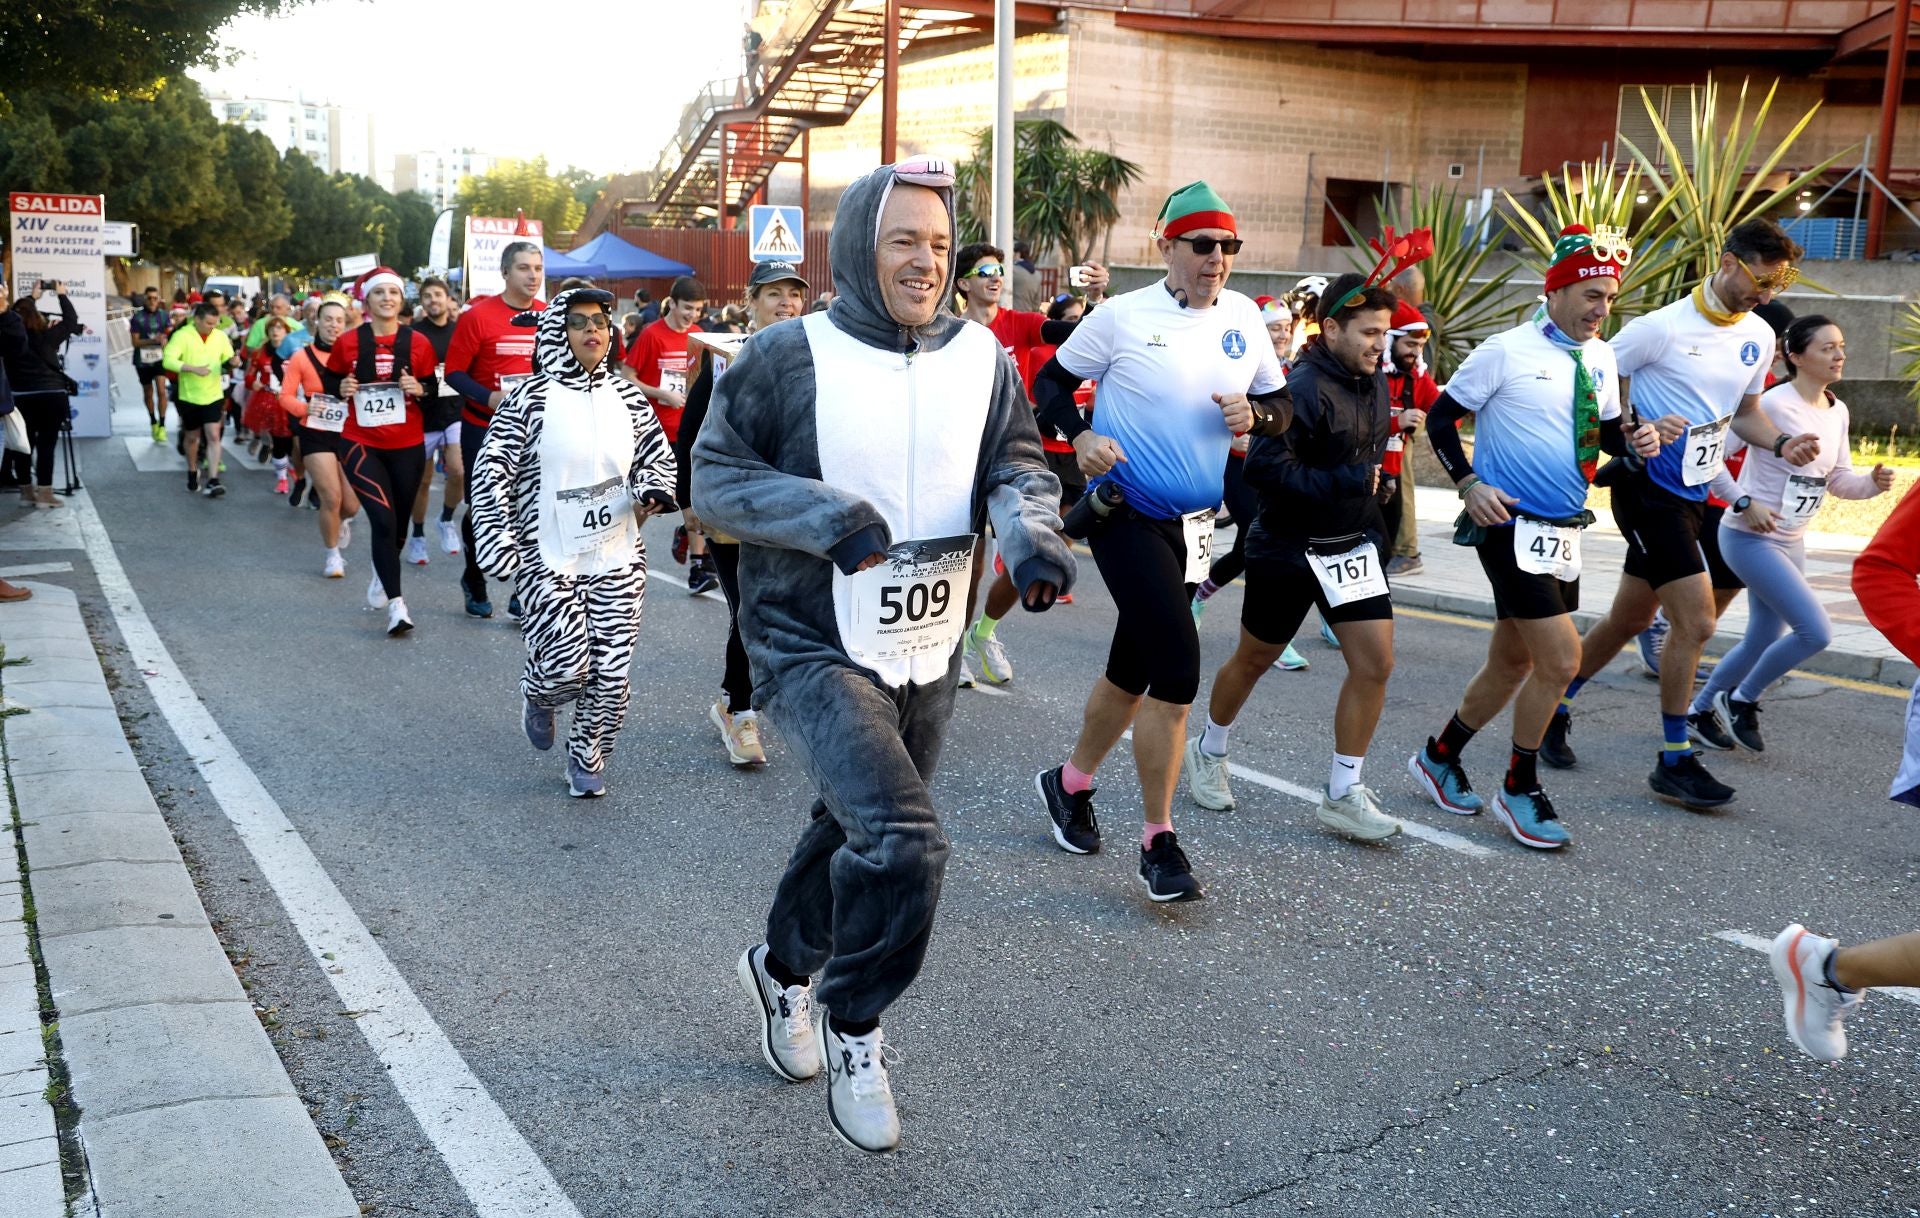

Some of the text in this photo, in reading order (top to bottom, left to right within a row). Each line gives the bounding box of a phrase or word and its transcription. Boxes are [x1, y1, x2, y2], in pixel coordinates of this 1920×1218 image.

[15, 197, 98, 213] SALIDA
[16, 217, 49, 230] XIV
[473, 220, 540, 235] SALIA
[22, 236, 42, 244] SAN
[45, 237, 94, 245] SILVESTRE
[473, 239, 500, 250] XIV
[15, 247, 102, 256] PALMA PALMILLA
[1578, 265, 1616, 278] DEER
[364, 397, 395, 414] 424
[582, 504, 612, 530] 46
[1530, 535, 1572, 561] 478
[940, 549, 971, 561] XIV
[929, 562, 967, 571] SILVESTRE
[932, 557, 968, 567] CARRERA
[927, 566, 967, 575] PALMILLA
[1327, 554, 1369, 584] 767
[879, 579, 951, 625] 509
